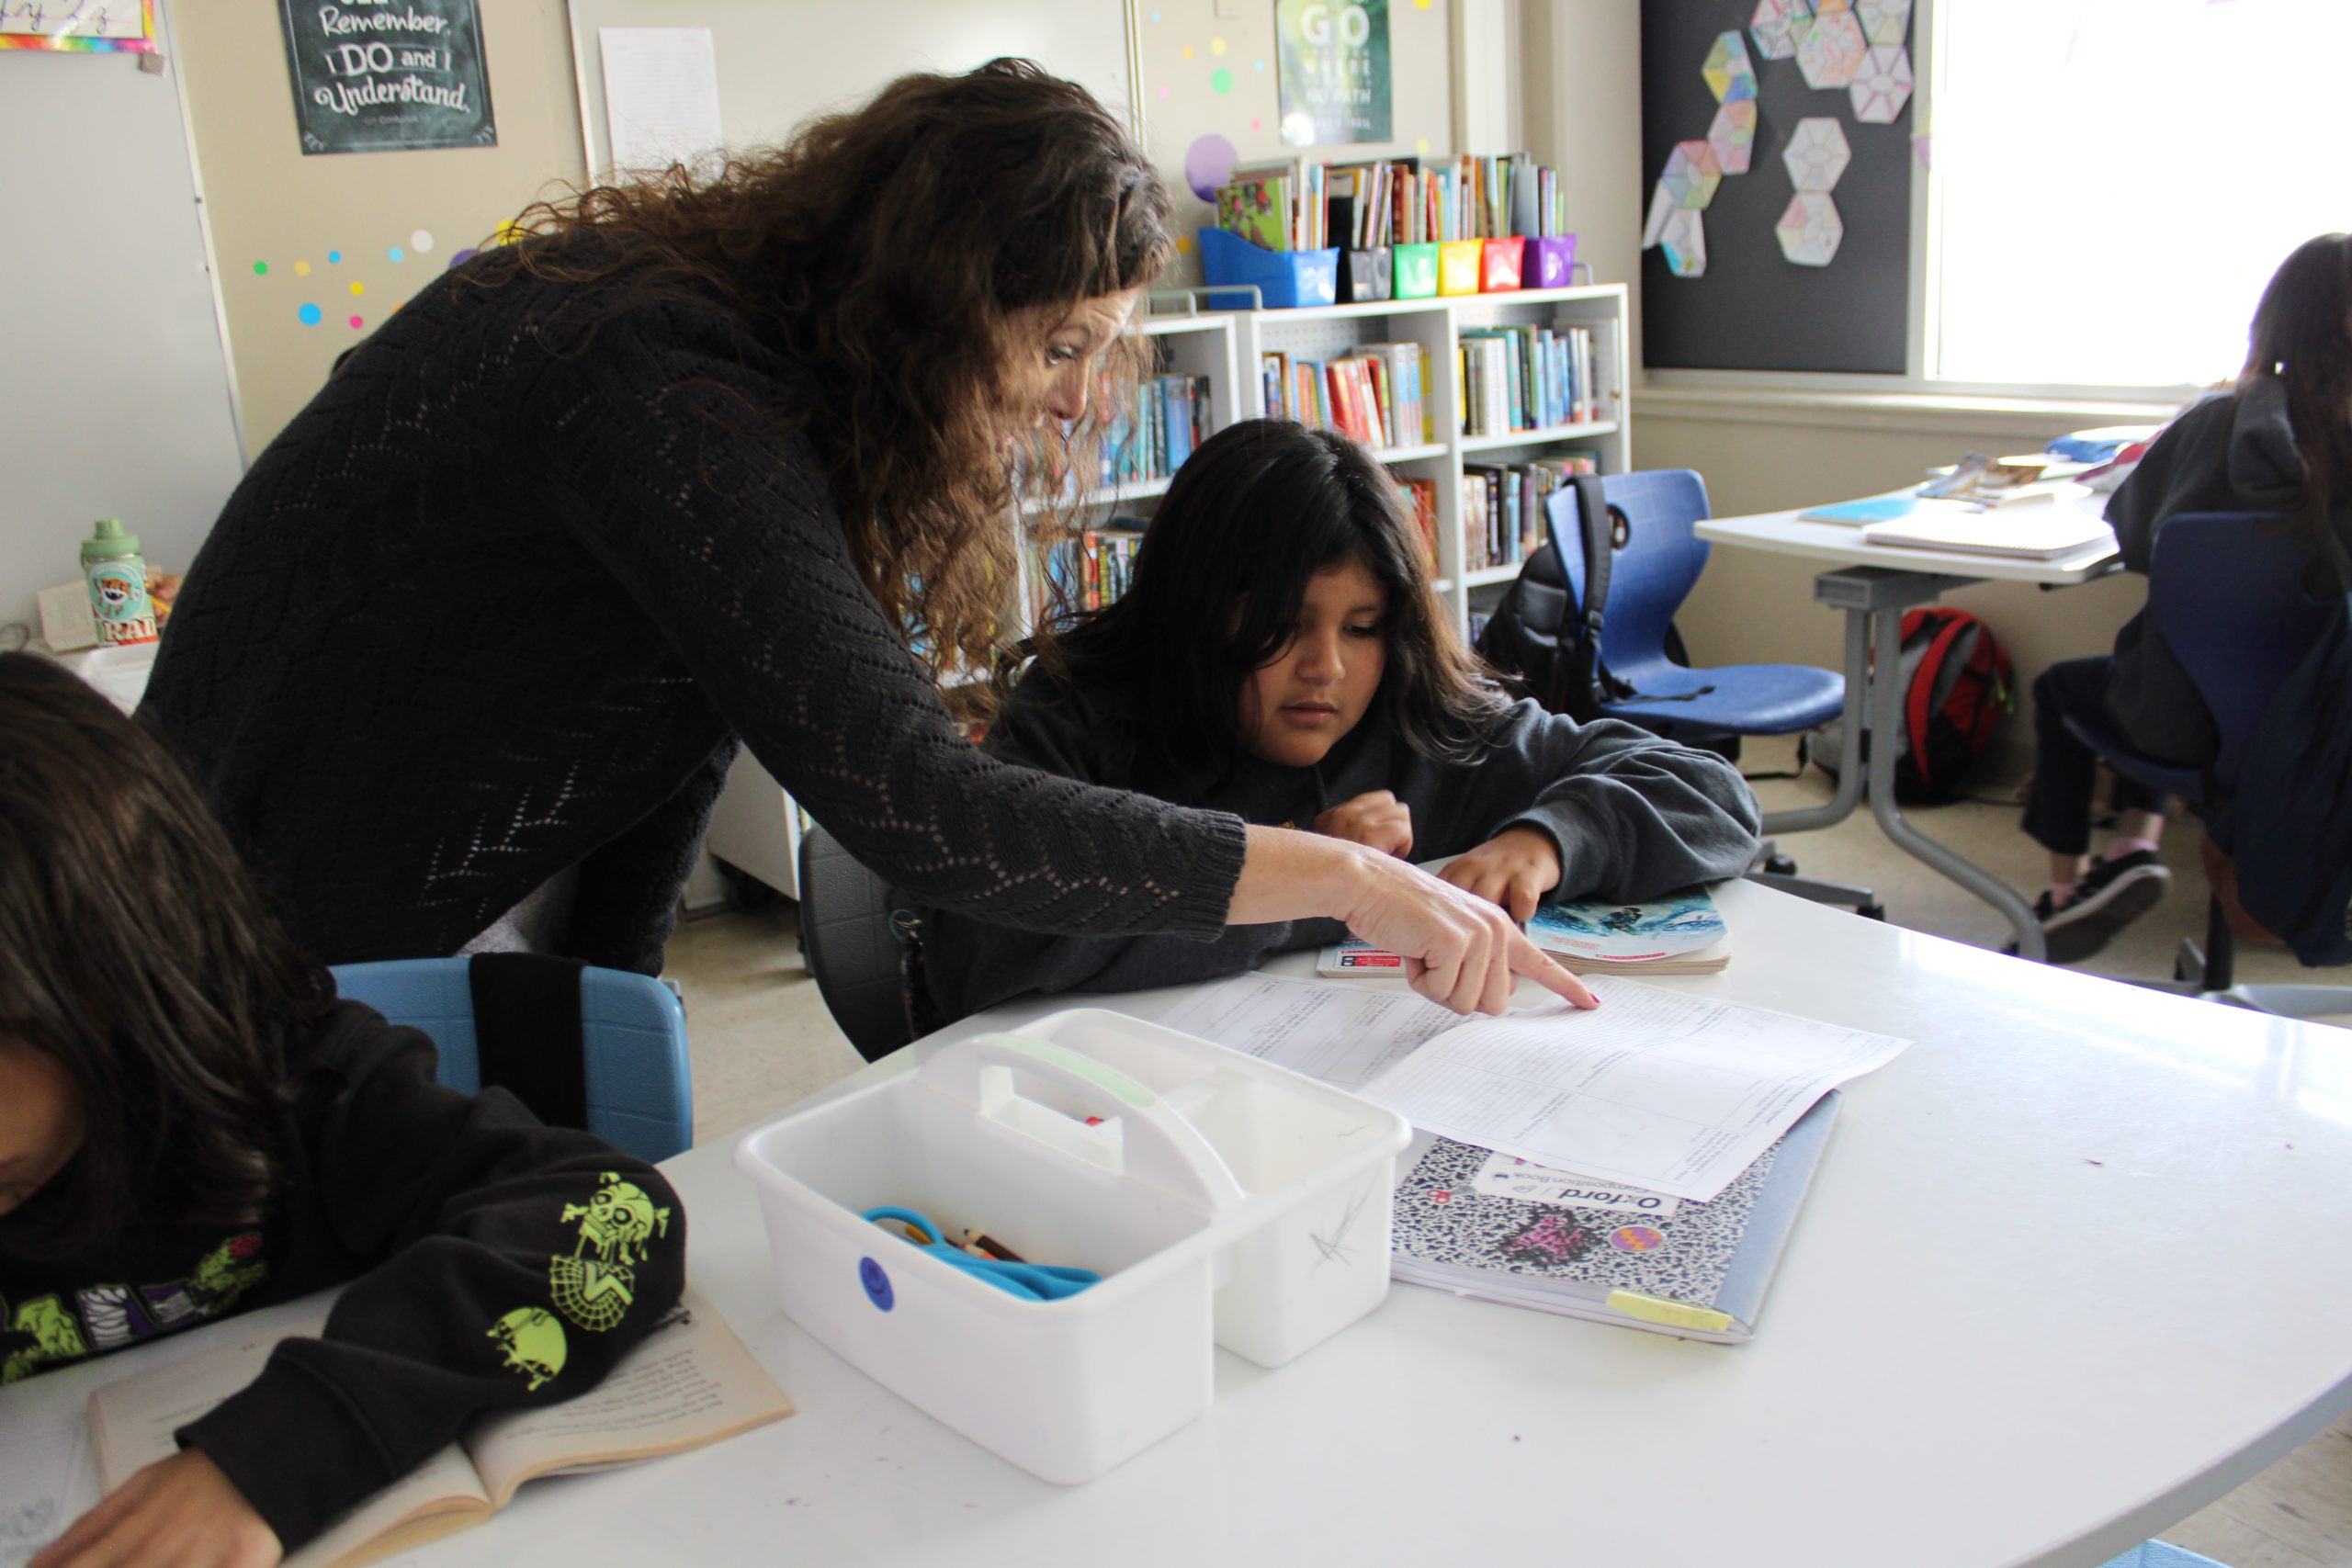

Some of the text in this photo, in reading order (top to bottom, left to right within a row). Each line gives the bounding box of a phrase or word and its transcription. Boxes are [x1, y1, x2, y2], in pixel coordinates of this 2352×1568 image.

[319, 6, 452, 37] Remember.
[1301, 4, 1370, 48] GO
[324, 41, 451, 76] I DO and I
[1513, 1171, 1551, 1184] Book
[1557, 1188, 1662, 1210] Oxford
